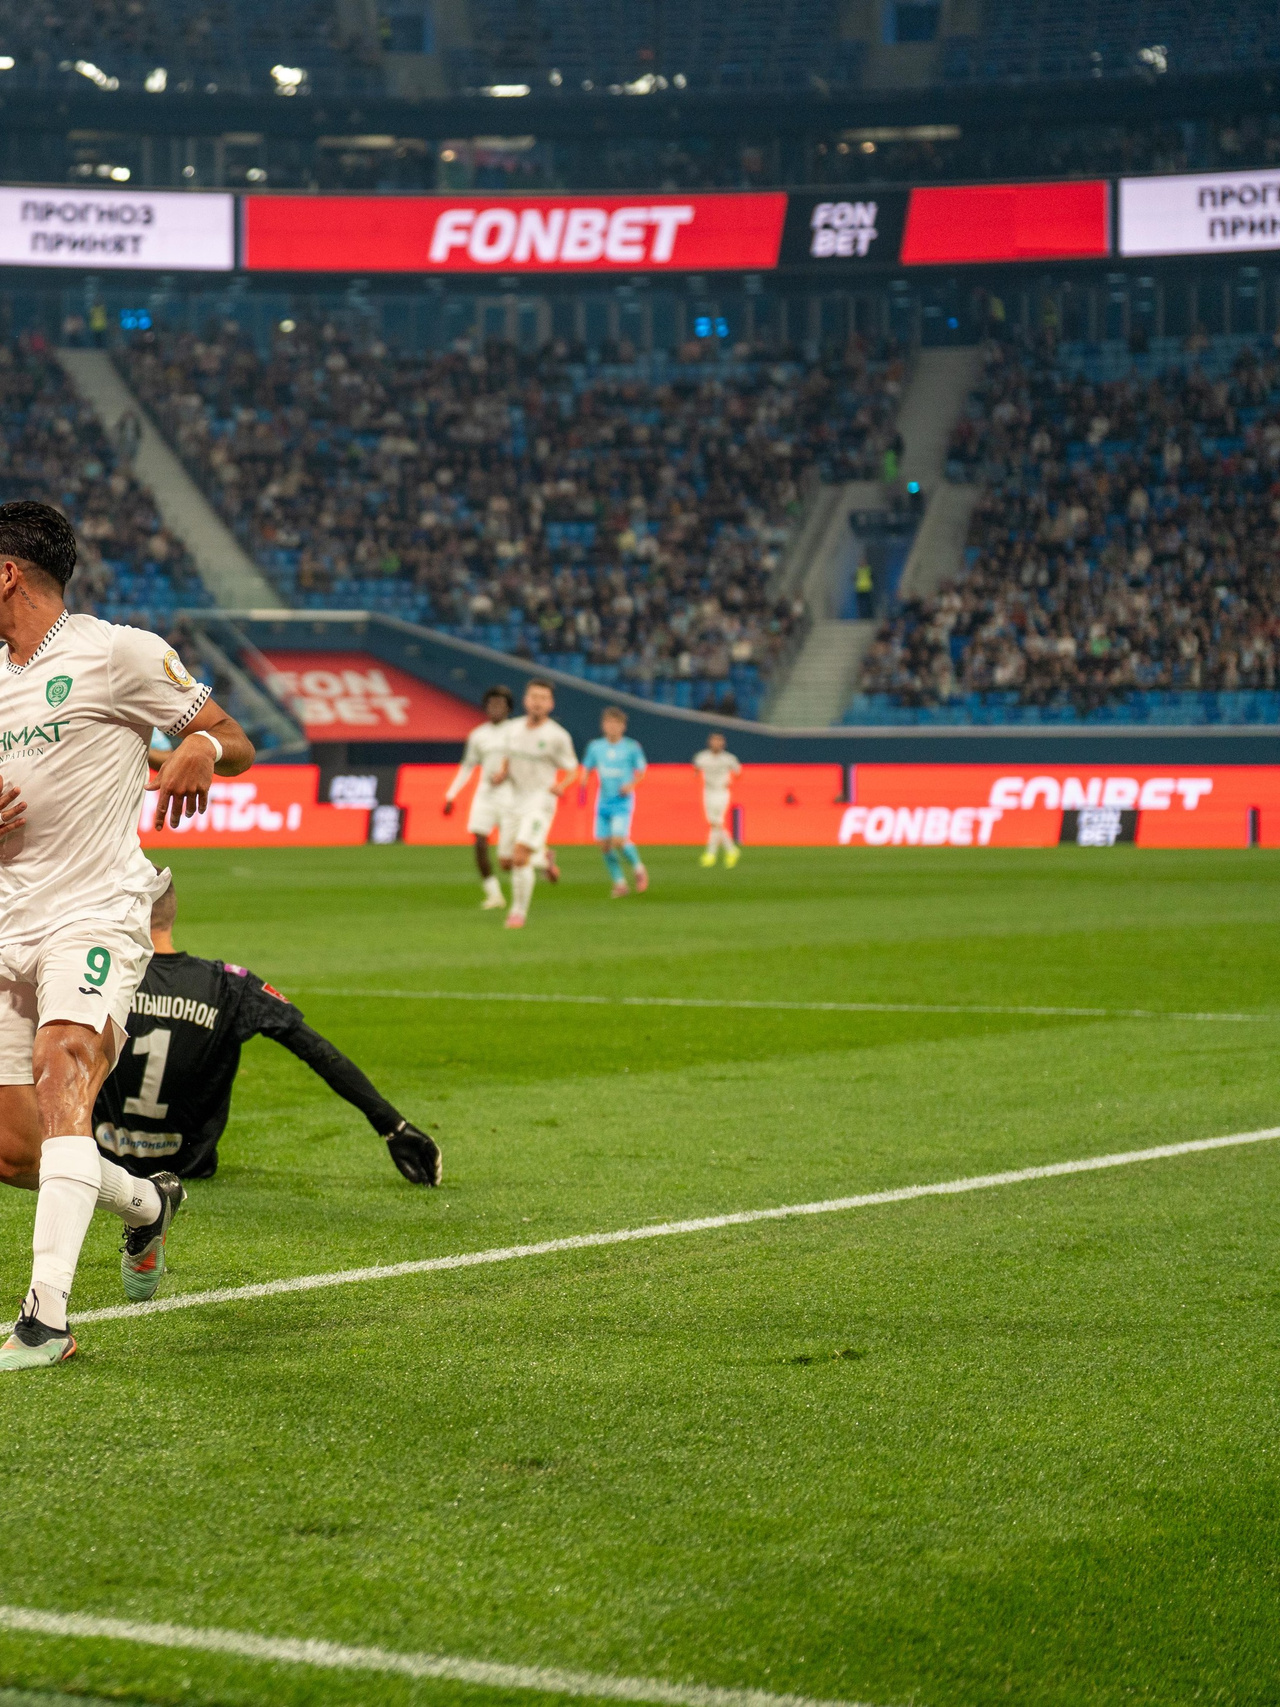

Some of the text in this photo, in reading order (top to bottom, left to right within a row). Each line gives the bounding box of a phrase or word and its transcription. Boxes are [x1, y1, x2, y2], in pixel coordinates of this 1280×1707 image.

[1198, 182, 1280, 208] ПРОГ
[21, 200, 154, 225] ПРОГНОЗ
[811, 201, 878, 229] FON
[31, 231, 142, 254] ПРИНЯТ
[429, 206, 694, 263] FONBET
[811, 228, 878, 257] BET
[292, 696, 410, 726] BET
[838, 806, 1003, 846] FONBET
[83, 946, 111, 987] 9
[123, 1028, 172, 1119] 1
